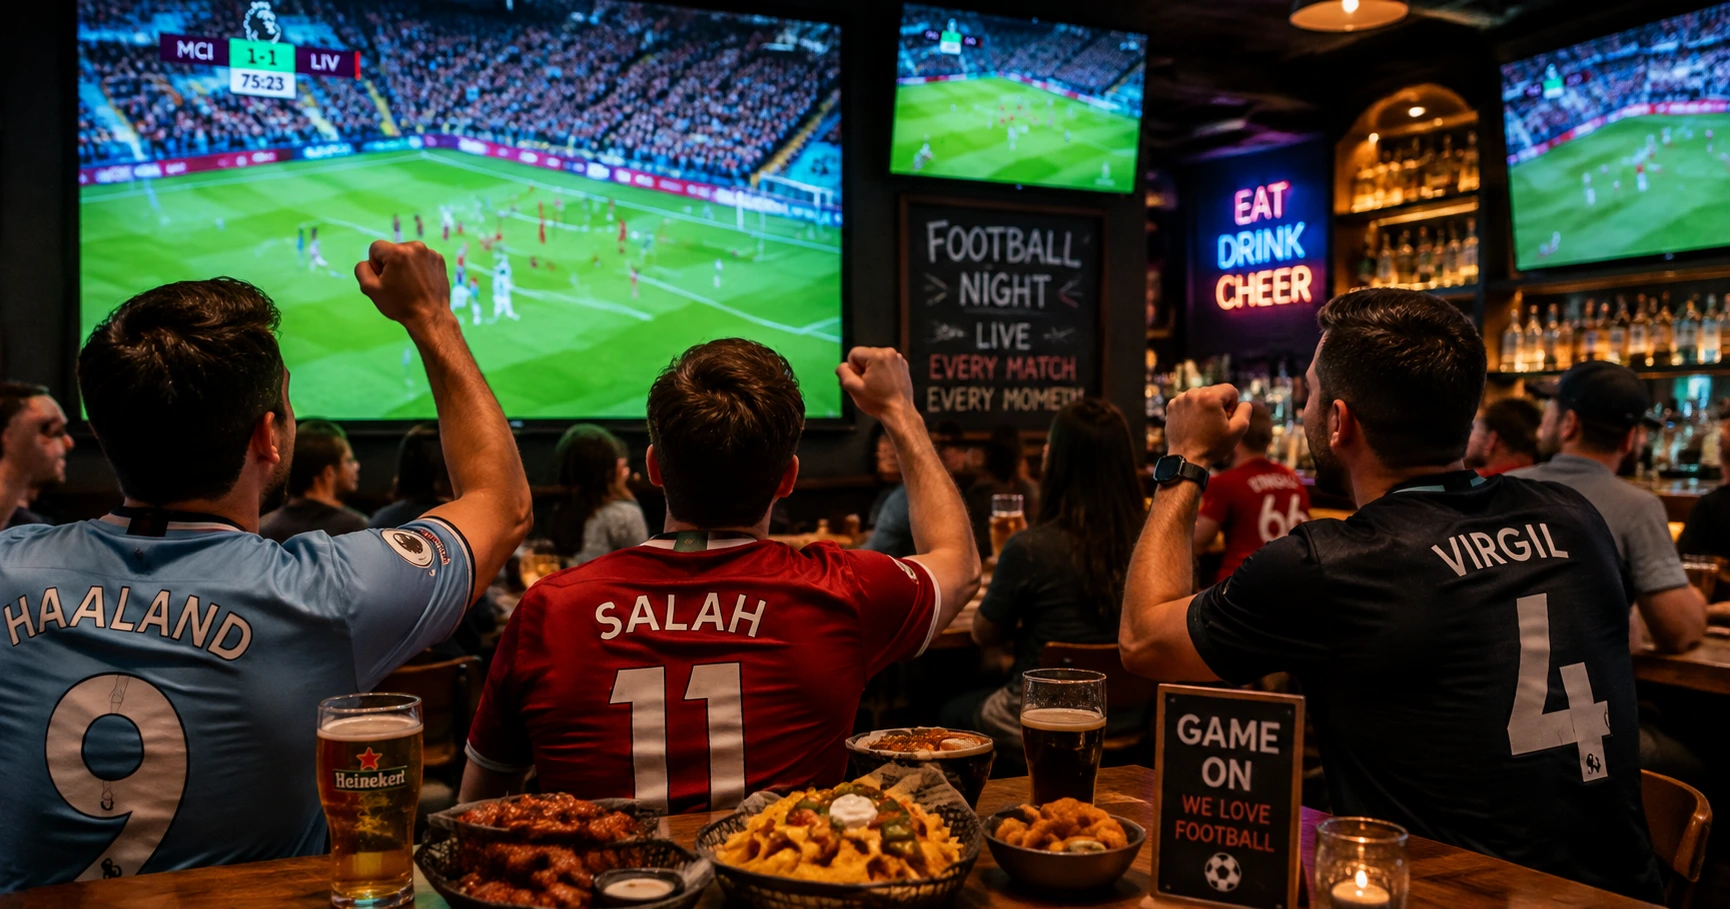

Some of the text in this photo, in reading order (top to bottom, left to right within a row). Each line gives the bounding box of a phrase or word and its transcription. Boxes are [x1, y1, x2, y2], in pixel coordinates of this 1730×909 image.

[176, 41, 340, 72] MCI 1-1 LIV
[241, 73, 285, 92] 75:23
[1234, 180, 1290, 226] EAT
[926, 219, 1082, 269] FOOTBALL
[1217, 221, 1306, 270] DRINK
[959, 270, 1051, 308] NIGHT
[1215, 265, 1313, 311] CHEER
[976, 321, 1031, 350] LIVE
[929, 353, 1077, 381] EVERY MATCH
[926, 386, 995, 414] EVERY
[1431, 523, 1569, 577] VIRGIL
[3, 586, 254, 661] HAALAND
[595, 592, 767, 640] SALAH
[1507, 592, 1612, 782] 4
[609, 662, 746, 815] 11
[1177, 713, 1280, 754] GAME
[45, 672, 190, 882] 9
[335, 770, 405, 788] Heineken
[1202, 756, 1252, 792] ON
[1182, 794, 1271, 825] WE LOVE
[1175, 820, 1275, 853] FOOTBALL
